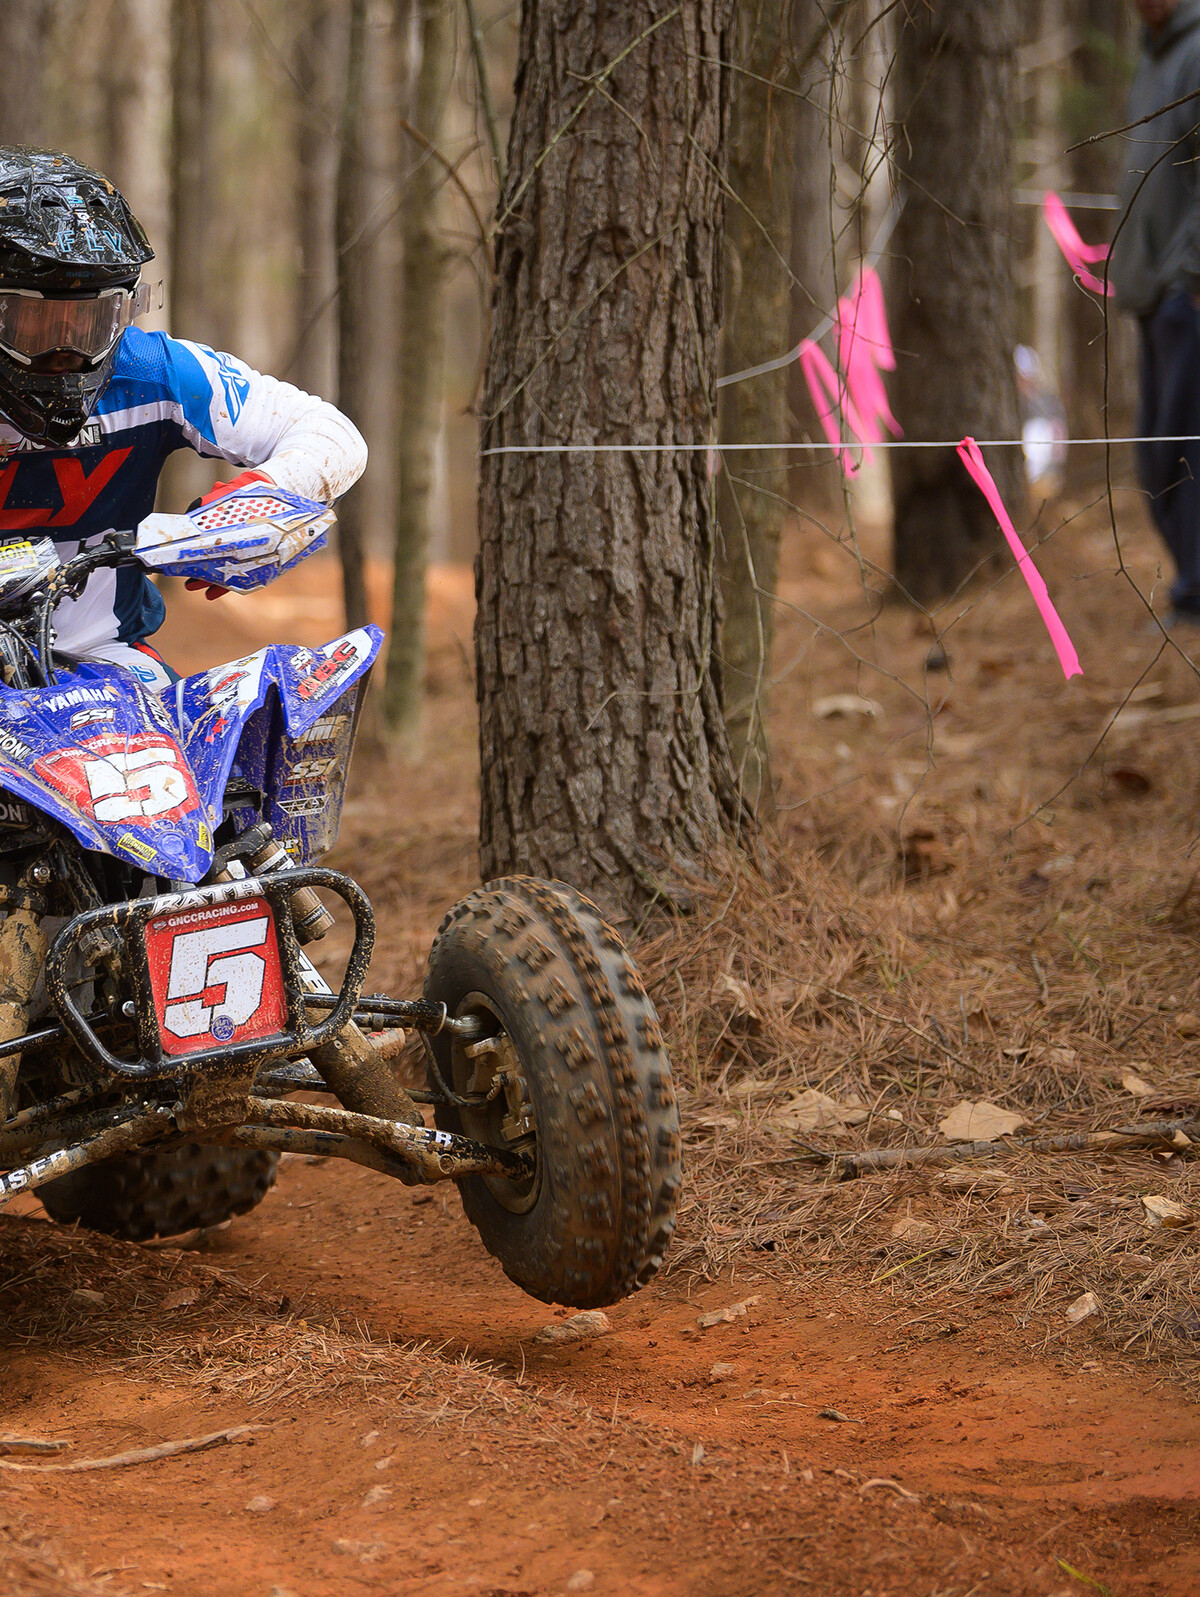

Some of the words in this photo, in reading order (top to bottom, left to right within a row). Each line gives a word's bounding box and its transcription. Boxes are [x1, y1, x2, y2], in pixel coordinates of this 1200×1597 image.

[58, 230, 122, 252] FLY
[44, 688, 116, 713] YAMAHA
[71, 709, 115, 728] SSI
[84, 746, 189, 823] 5
[151, 879, 265, 916] RATH
[163, 916, 270, 1039] 5
